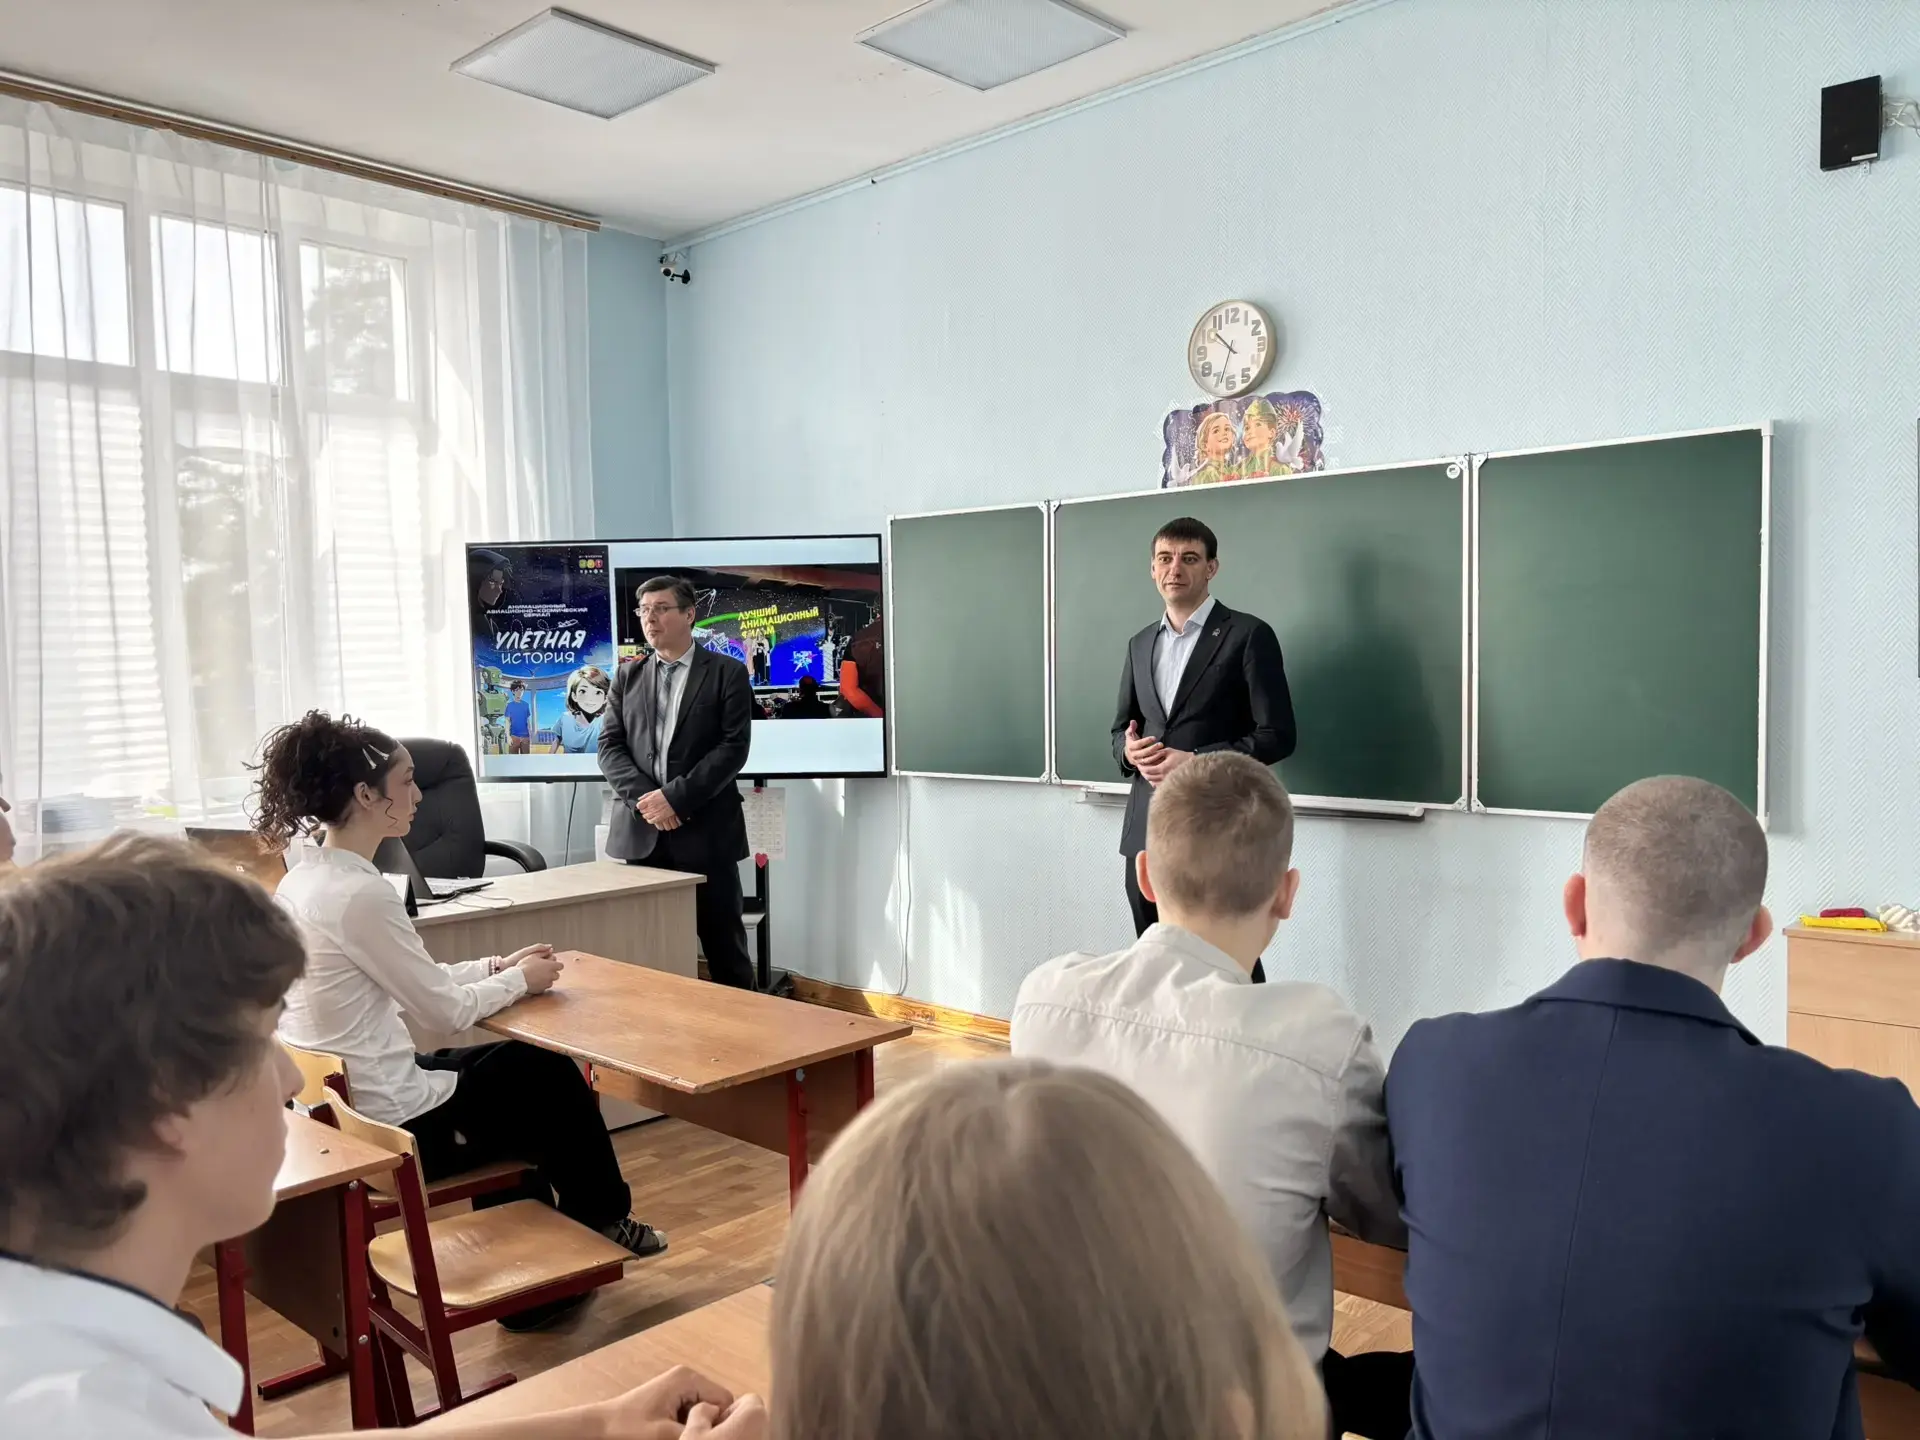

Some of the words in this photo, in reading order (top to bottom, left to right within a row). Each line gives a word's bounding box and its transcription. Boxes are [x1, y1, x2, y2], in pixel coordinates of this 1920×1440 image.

[1213, 314, 1222, 330] 11
[1225, 307, 1240, 325] 12
[1244, 310, 1249, 326] 1
[1251, 319, 1262, 336] 2
[1201, 328, 1218, 344] 10
[1257, 336, 1266, 353] 3
[1197, 346, 1207, 361] 9
[1250, 353, 1262, 368] 4
[1201, 361, 1212, 377] 8
[1241, 367, 1251, 384] 5
[1213, 371, 1222, 388] 7
[1225, 374, 1236, 391] 6
[738, 605, 778, 620] ЛУЧШИЙ
[740, 607, 819, 629] АНИМАЦИОННЫЙ
[496, 628, 587, 649] УЛЁТНАЯ
[501, 652, 575, 664] ИСТОРИЯ
